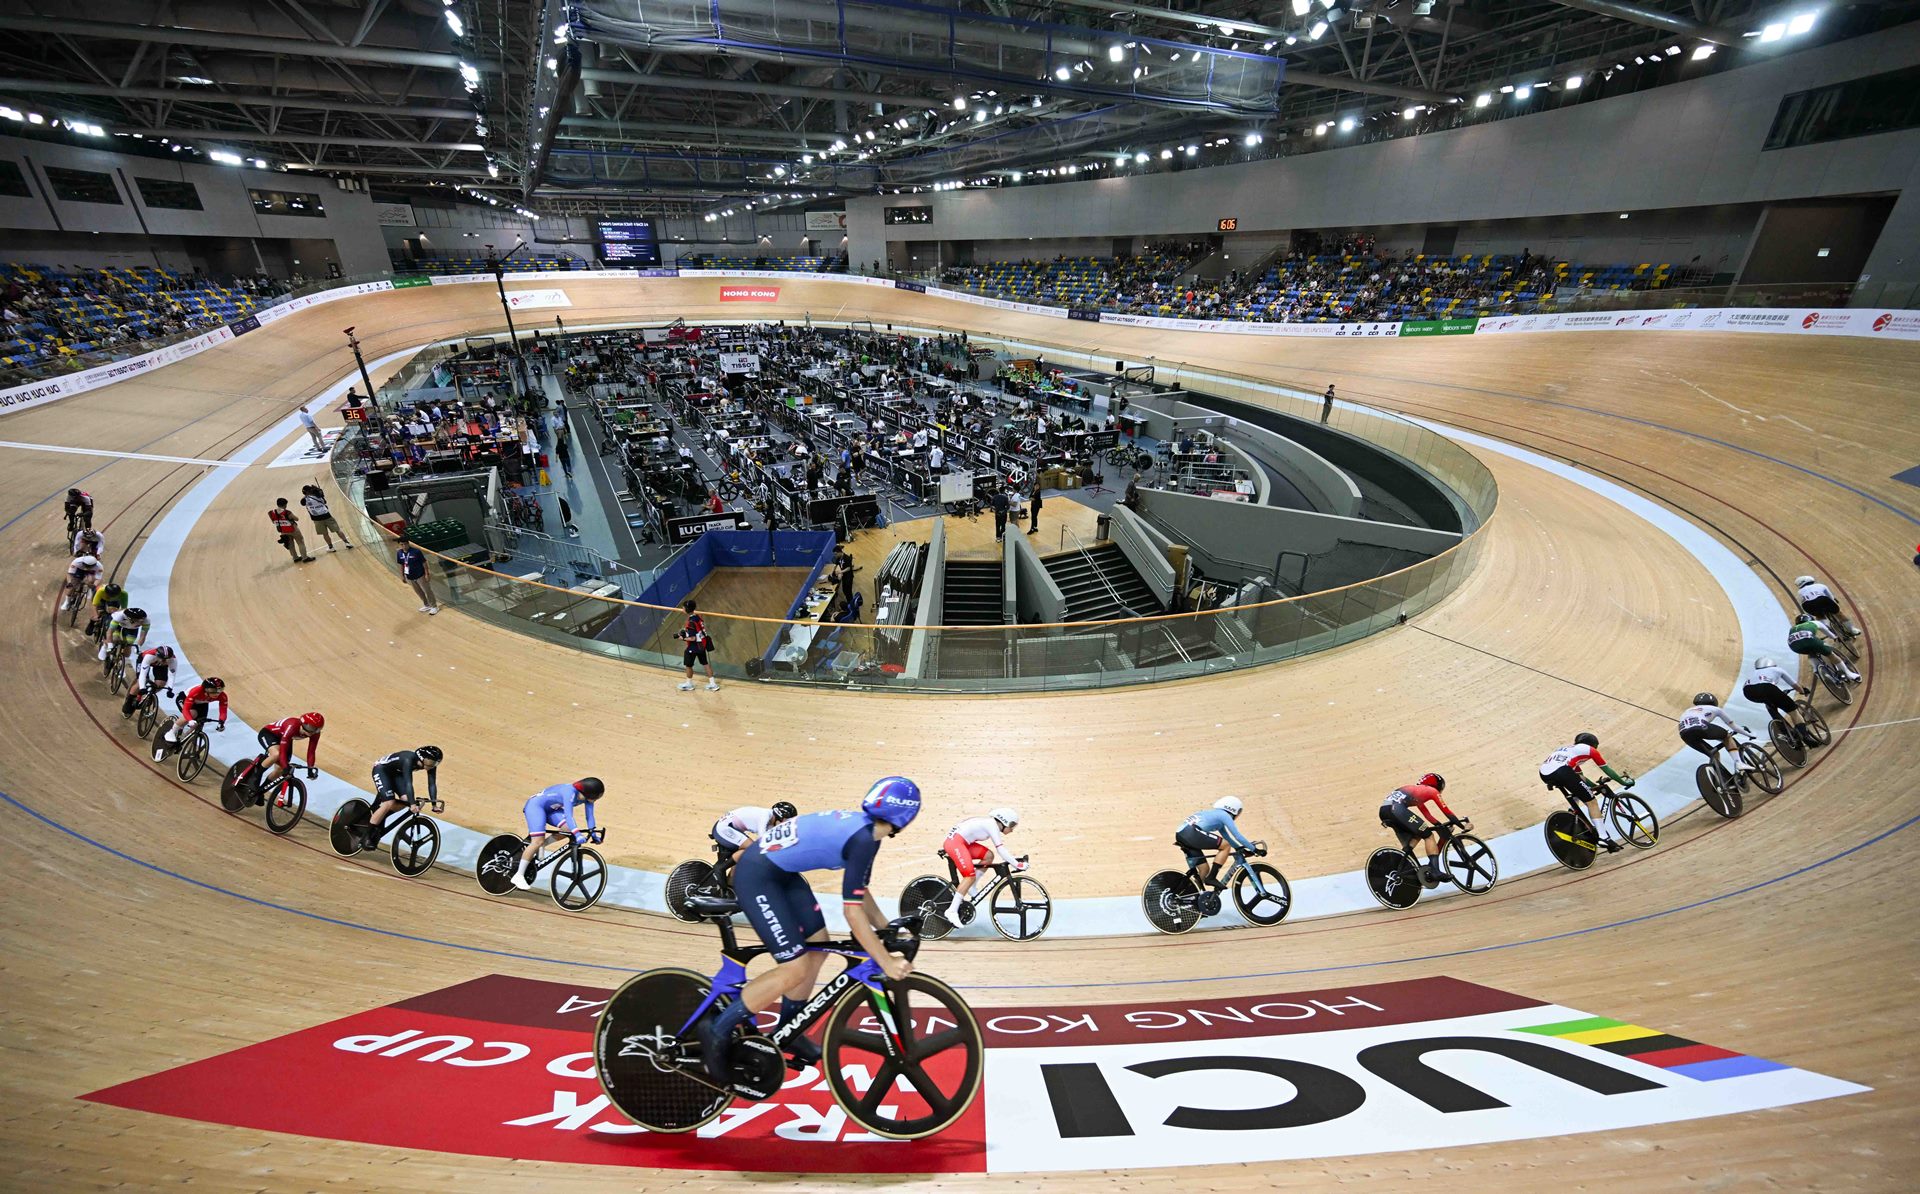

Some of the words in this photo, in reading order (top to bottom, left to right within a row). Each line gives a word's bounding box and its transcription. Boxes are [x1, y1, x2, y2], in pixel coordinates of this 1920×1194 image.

[346, 410, 361, 420] 36
[684, 524, 706, 535] UCI
[373, 773, 384, 792] NZL
[886, 795, 920, 807] RUDY
[756, 894, 789, 946] CASTELLI
[773, 973, 849, 1045] PINARELLO
[1124, 996, 1385, 1029] HONG
[333, 1029, 531, 1067] CUP
[1040, 1036, 1668, 1139] UCI
